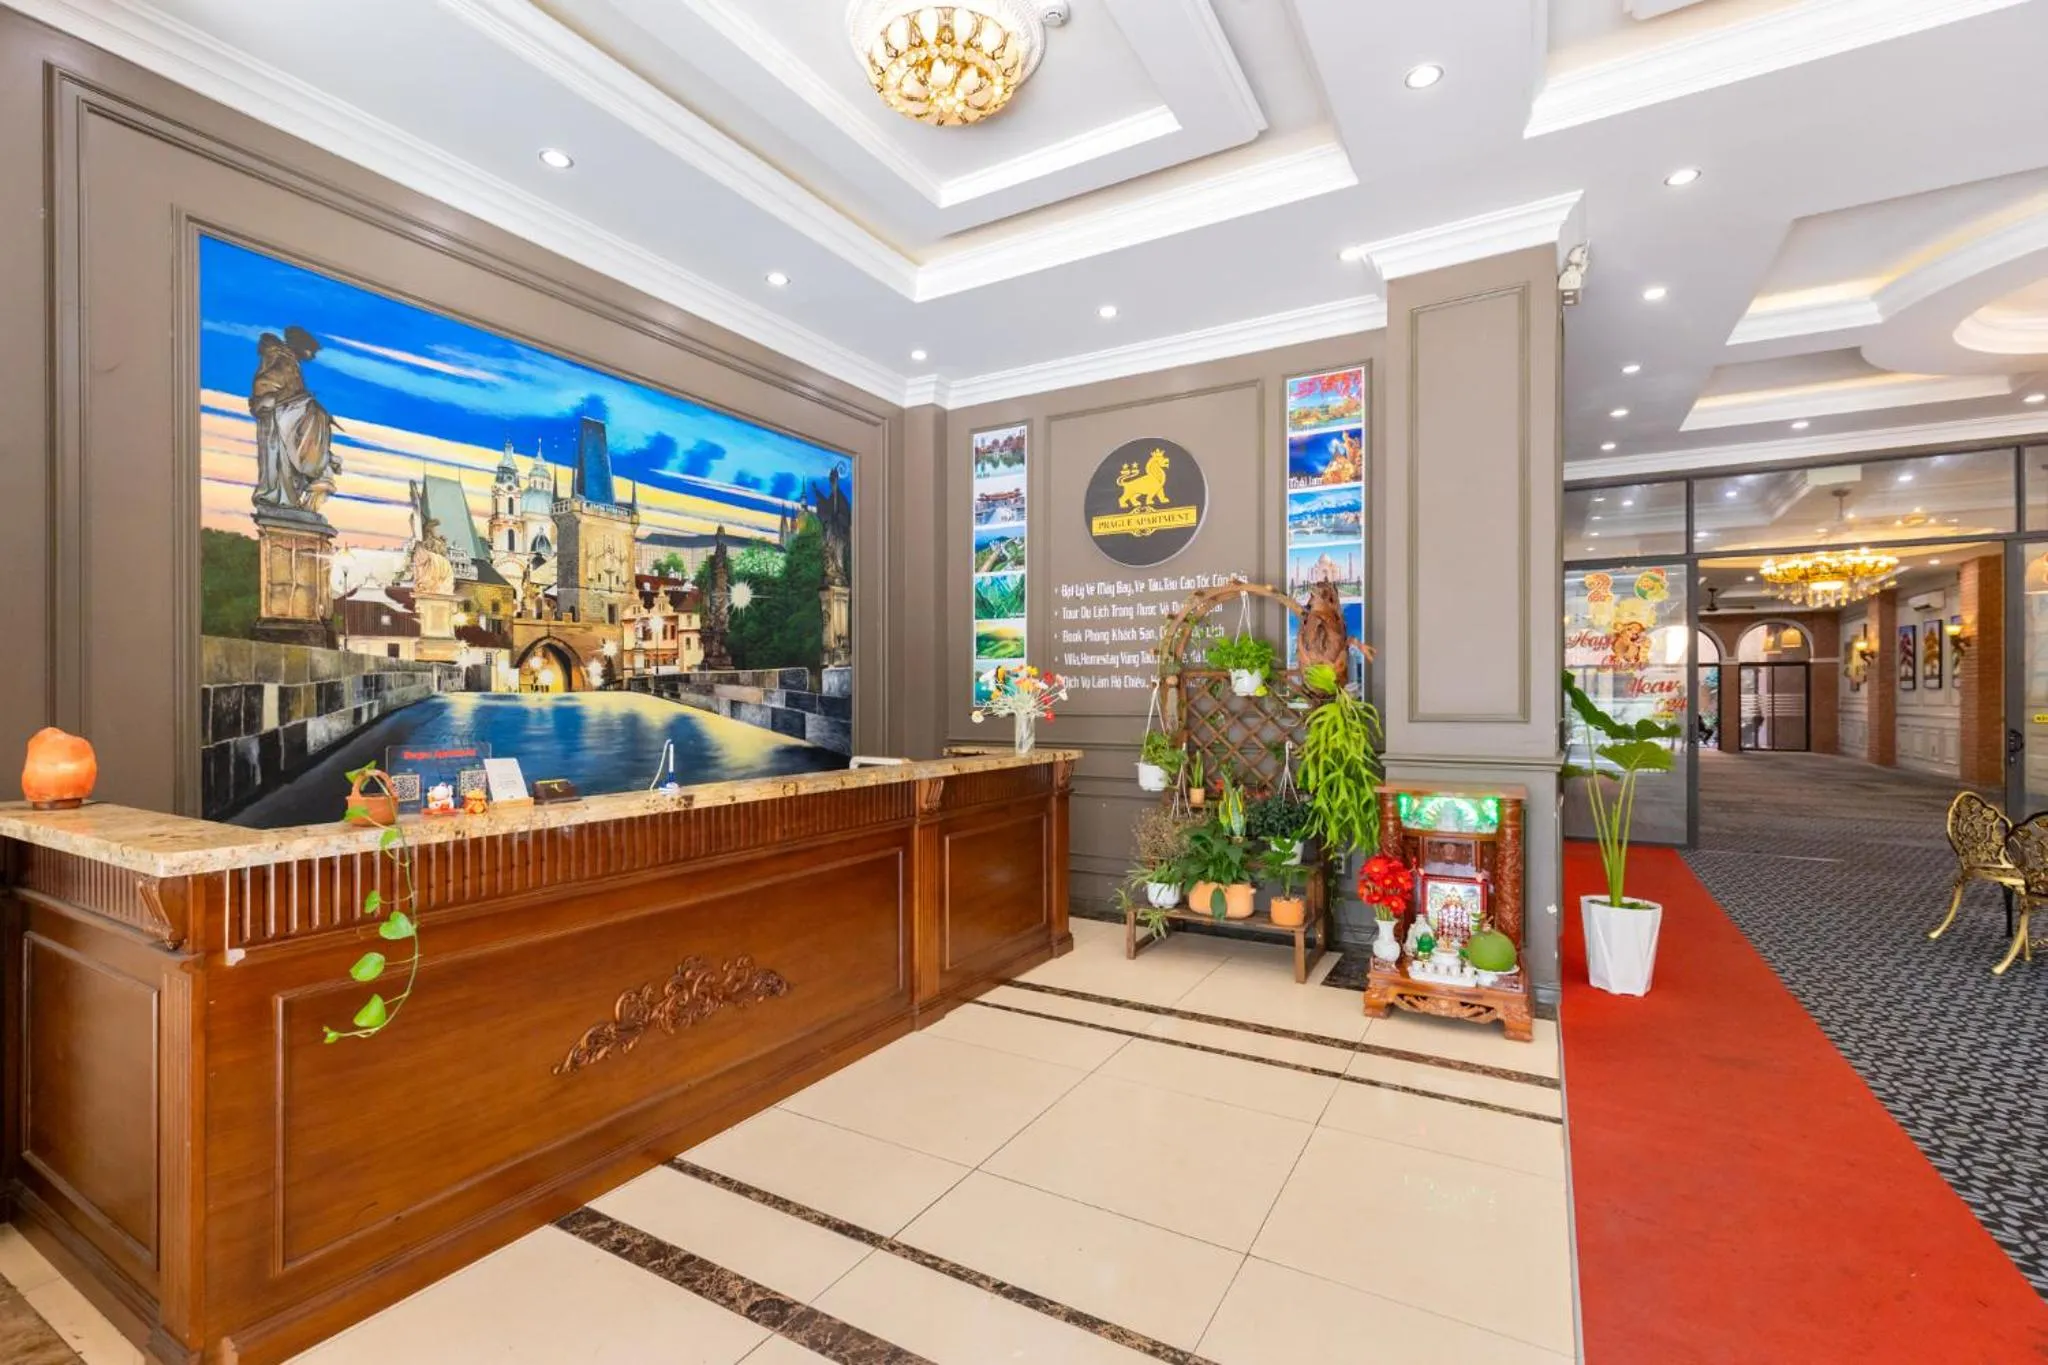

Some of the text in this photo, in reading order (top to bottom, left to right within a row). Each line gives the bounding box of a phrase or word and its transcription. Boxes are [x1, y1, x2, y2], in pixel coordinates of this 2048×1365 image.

[1098, 513, 1189, 529] PRAGUE APARTMENT
[1062, 606, 1078, 620] Tour
[1111, 603, 1134, 620] Trong
[1062, 629, 1082, 643] Book
